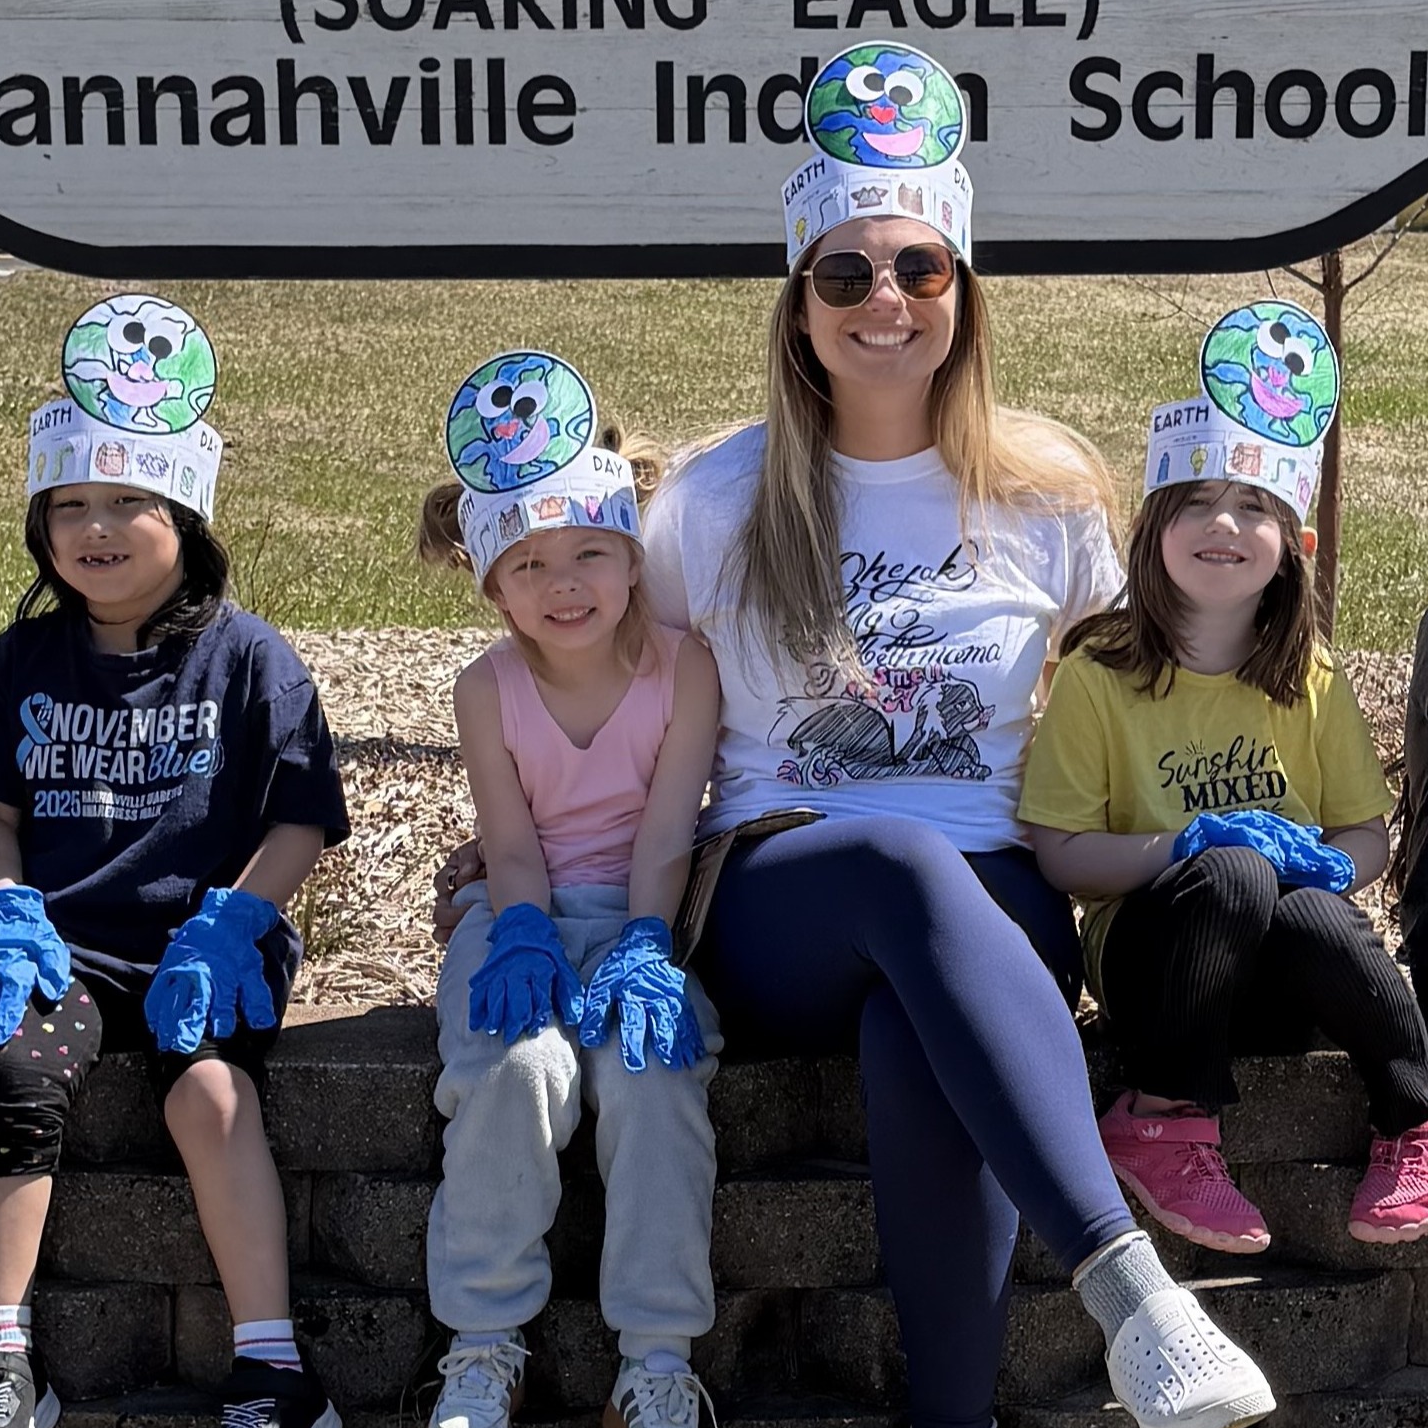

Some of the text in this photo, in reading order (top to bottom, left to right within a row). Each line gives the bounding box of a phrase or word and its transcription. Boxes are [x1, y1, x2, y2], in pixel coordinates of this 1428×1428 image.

[656, 57, 988, 144] Indn
[1070, 50, 1428, 141] School
[784, 158, 826, 206] EARTH
[33, 406, 72, 436] EARTH
[1154, 404, 1210, 433] EARTH
[592, 455, 623, 479] DAY
[873, 664, 945, 688] smell
[50, 699, 219, 747] NOVEMBER
[25, 740, 211, 785] WE WEAR Blue
[1158, 735, 1279, 789] Sunshin
[33, 790, 81, 818] 2025
[1181, 770, 1288, 813] MIXED
